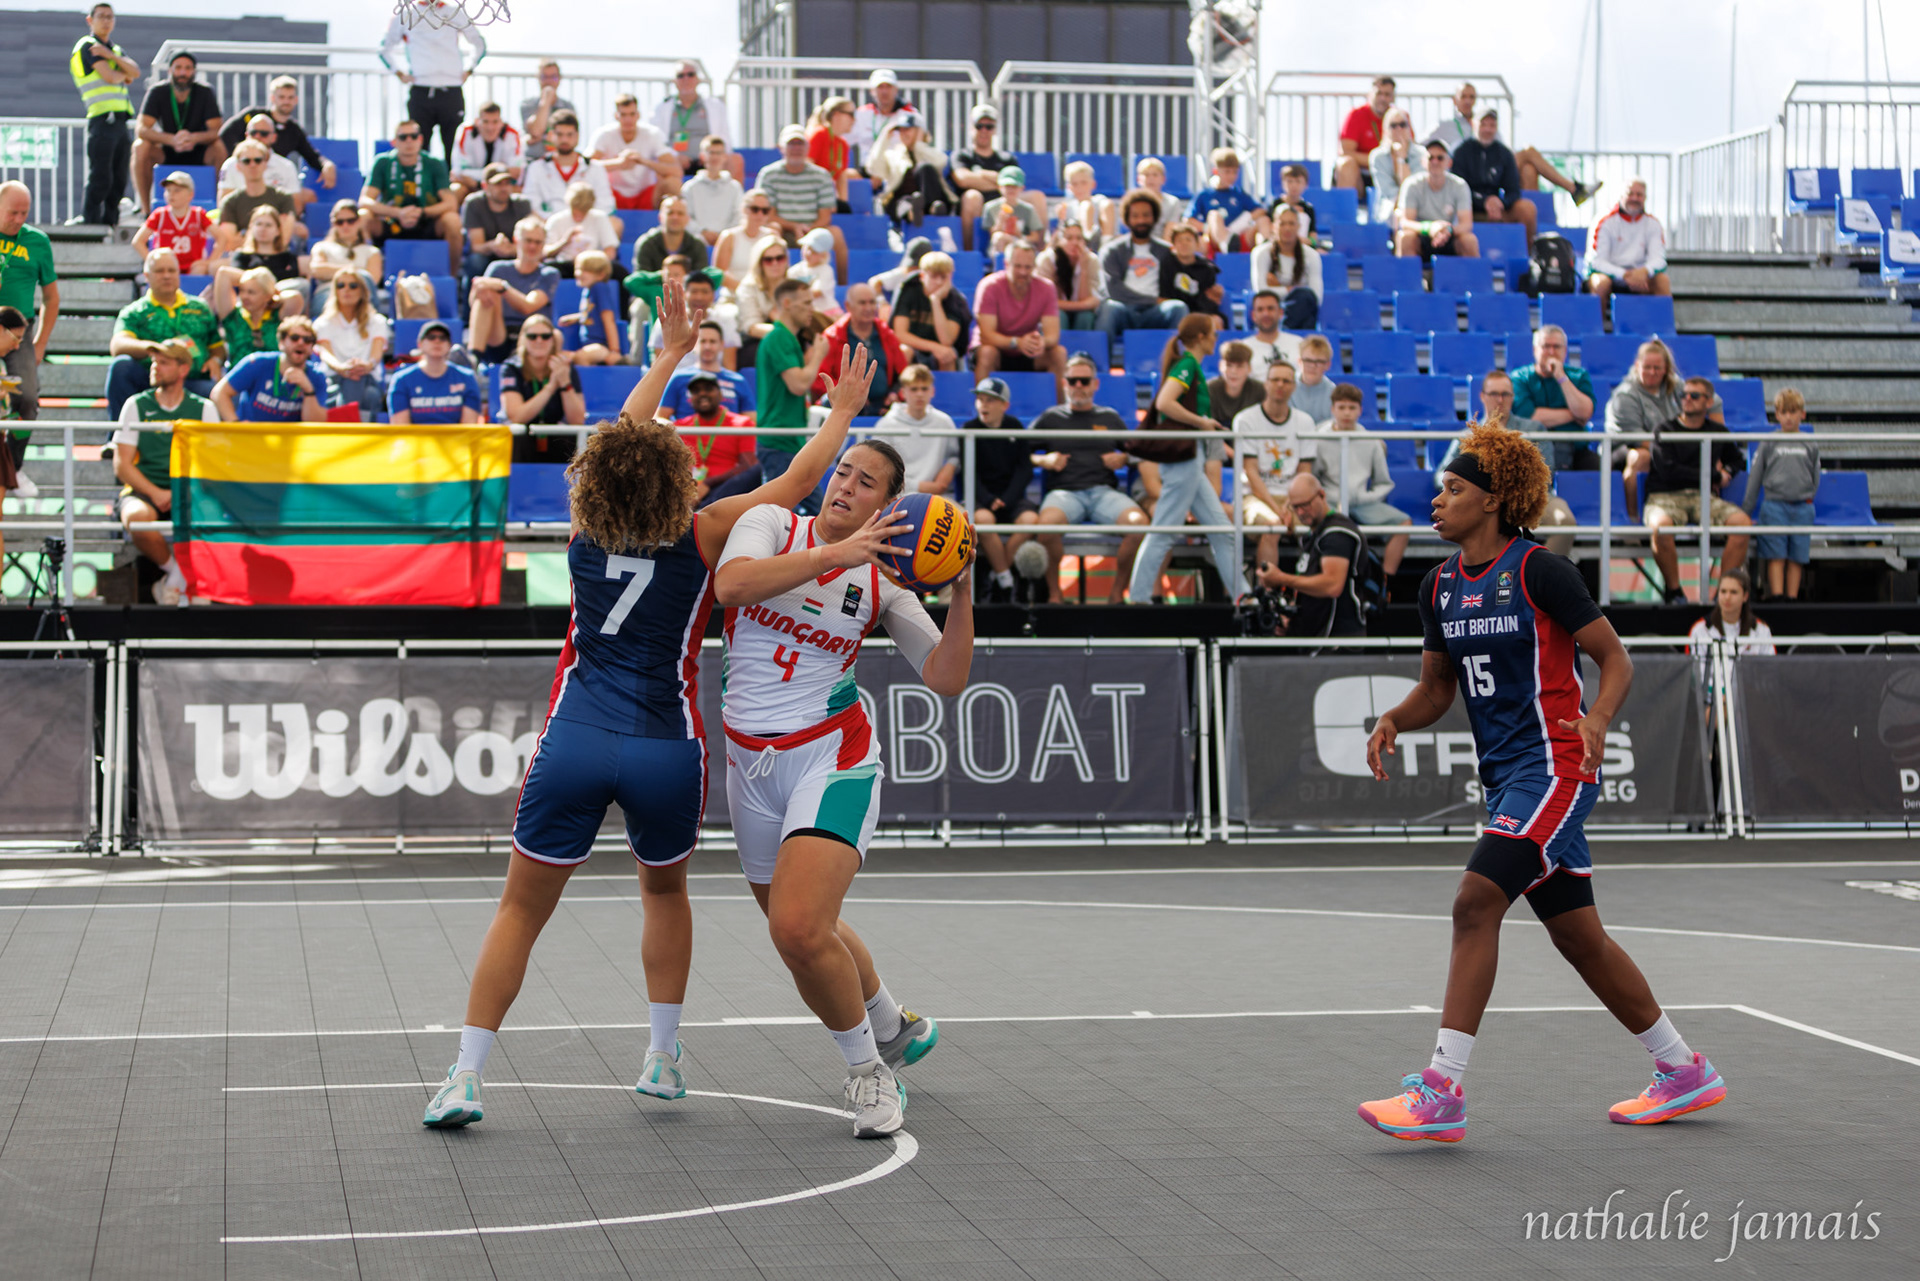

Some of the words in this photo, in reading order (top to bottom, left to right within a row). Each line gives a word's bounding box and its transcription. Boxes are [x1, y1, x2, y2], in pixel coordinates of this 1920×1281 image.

[923, 501, 954, 556] Wilson
[600, 554, 656, 635] 7
[742, 603, 858, 656] HUNGARY
[1441, 620, 1466, 639] REAT
[1468, 615, 1519, 636] BRITAIN
[773, 644, 800, 683] 4
[1462, 654, 1496, 697] 15
[858, 682, 1146, 784] BOAT
